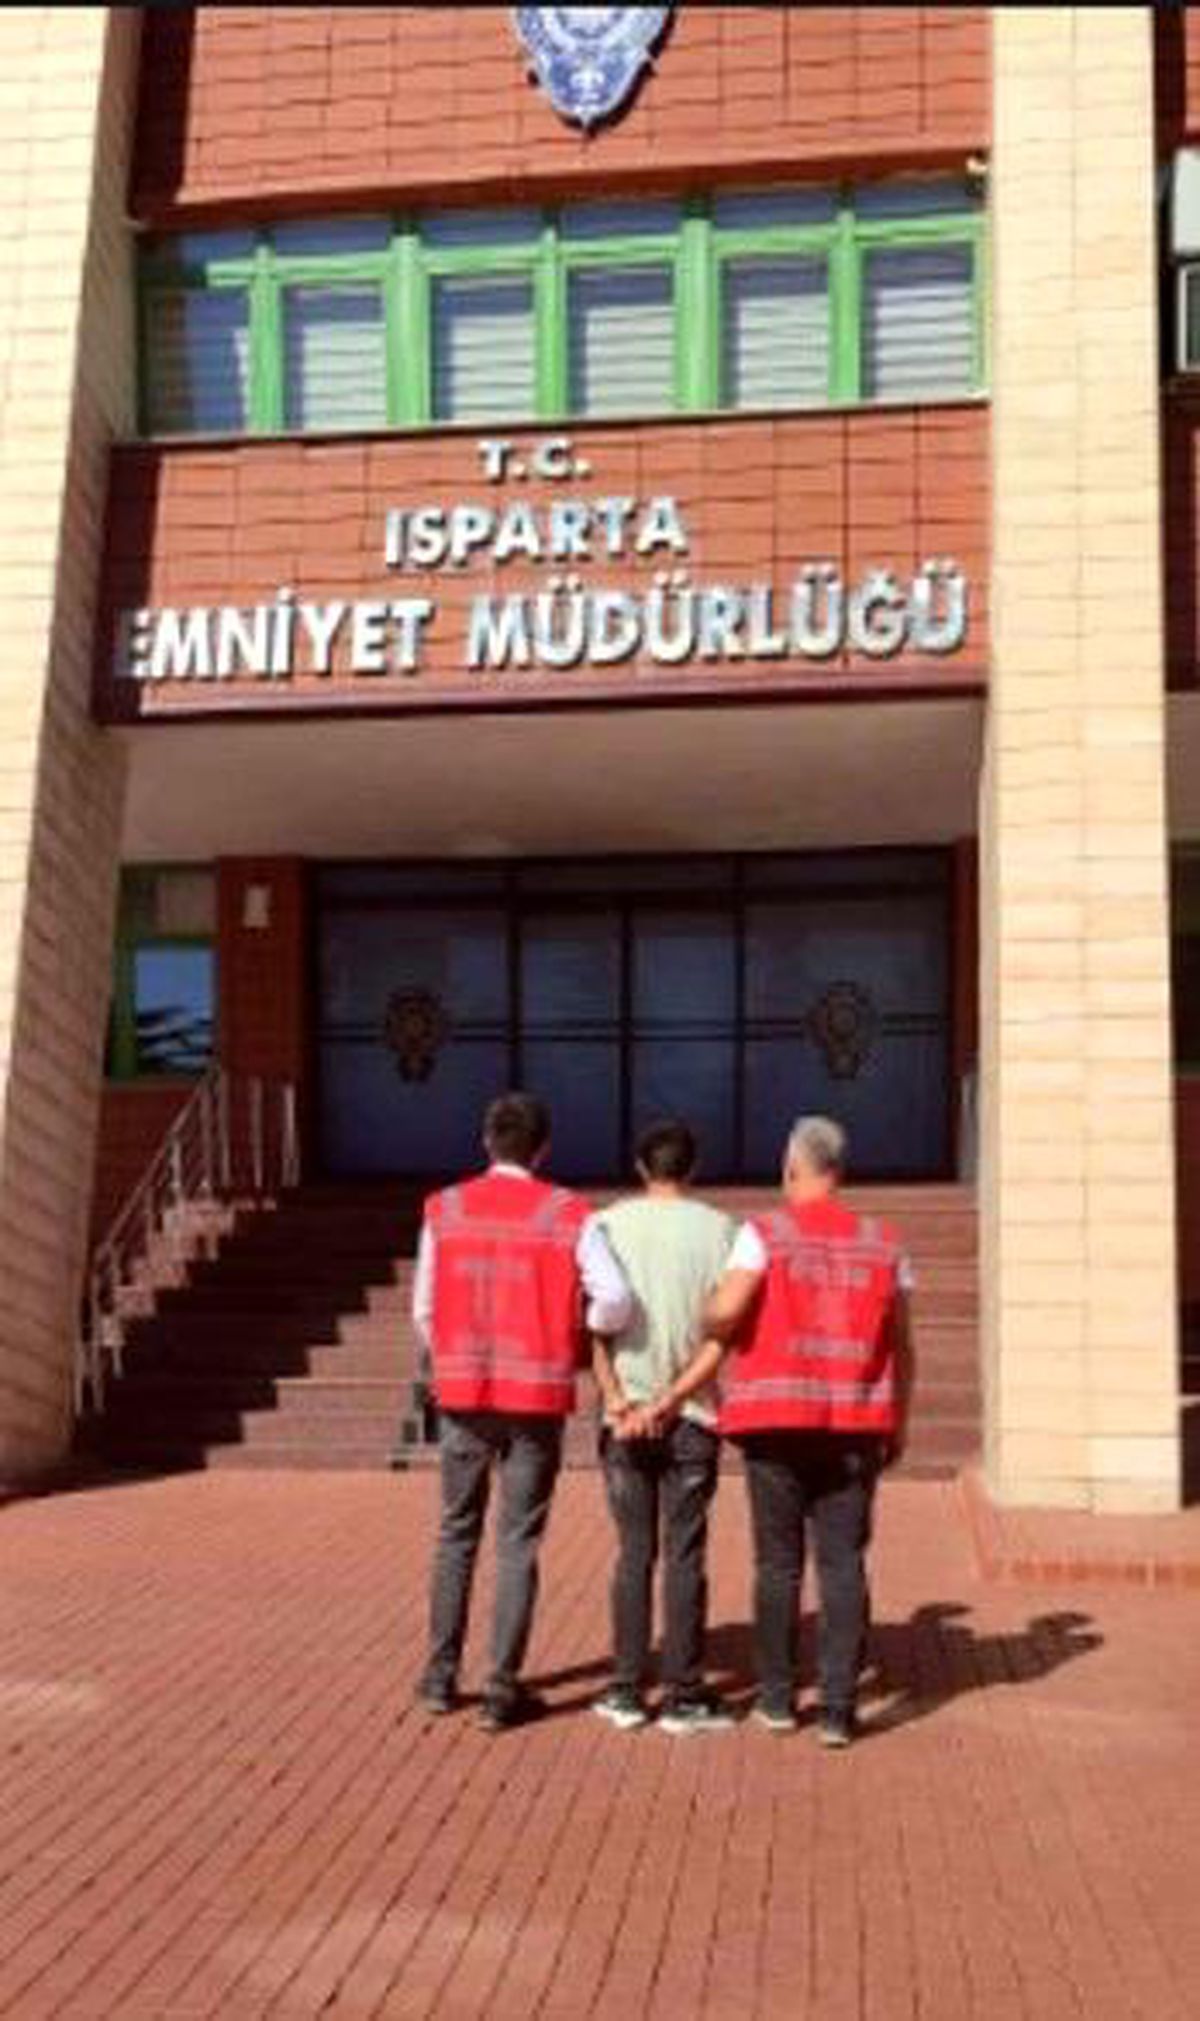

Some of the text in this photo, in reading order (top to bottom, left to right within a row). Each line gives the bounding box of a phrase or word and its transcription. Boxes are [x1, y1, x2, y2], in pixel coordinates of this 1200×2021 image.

[477, 439, 592, 481] T.C.
[384, 496, 690, 568] ISPARTA
[119, 561, 968, 680] EMNİYET MÜDÜRLÜĞÜ
